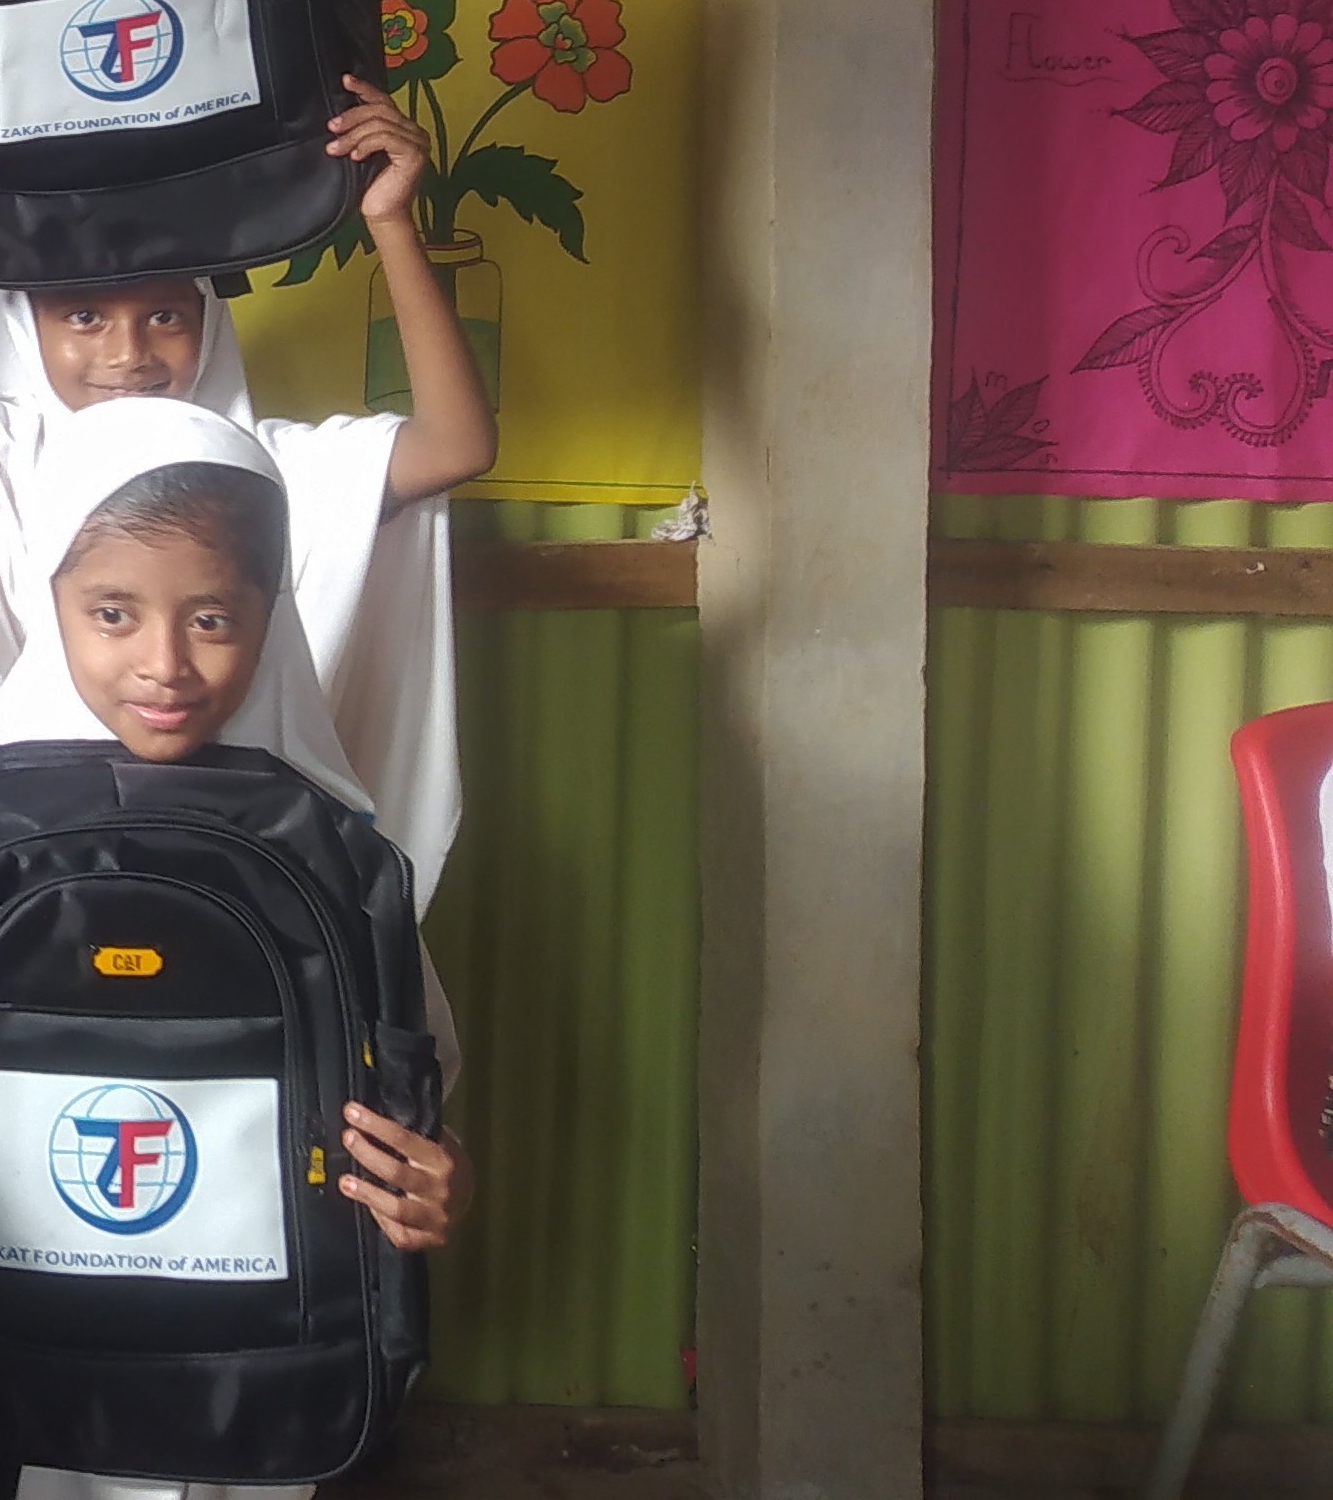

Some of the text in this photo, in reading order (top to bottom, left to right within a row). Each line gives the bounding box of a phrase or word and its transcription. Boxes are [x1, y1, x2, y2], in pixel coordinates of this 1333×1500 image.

[0, 91, 252, 139] ZAKAT FOUNDATION of AMERICA
[34, 1250, 162, 1270] FOUNDATION
[167, 1255, 186, 1271] of
[192, 1256, 277, 1273] AMERICA
